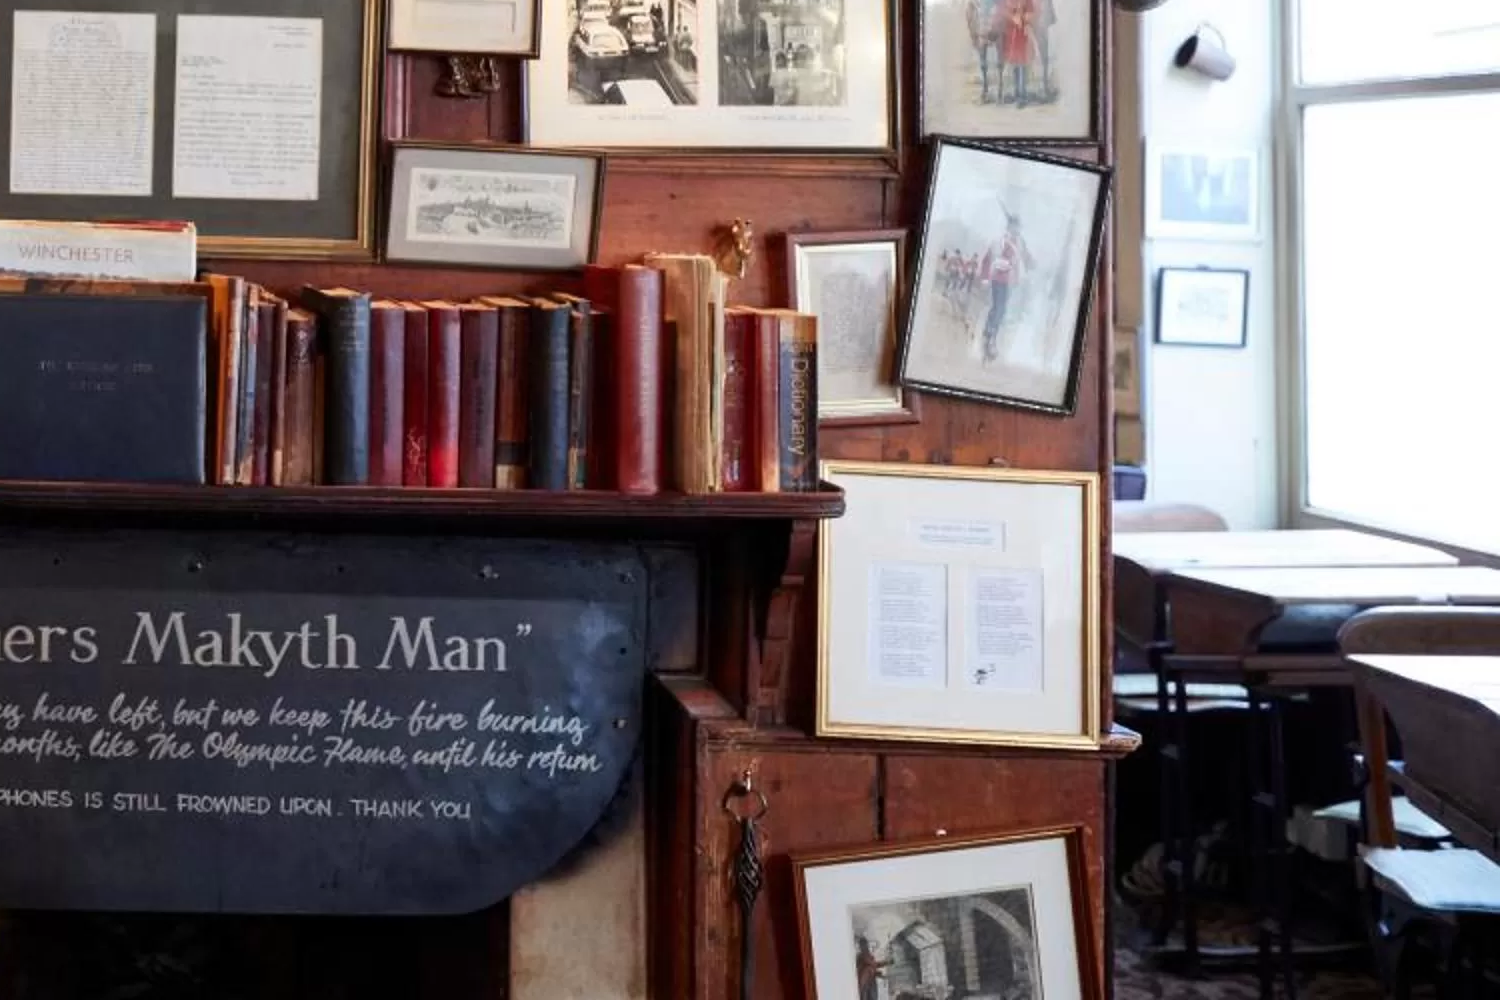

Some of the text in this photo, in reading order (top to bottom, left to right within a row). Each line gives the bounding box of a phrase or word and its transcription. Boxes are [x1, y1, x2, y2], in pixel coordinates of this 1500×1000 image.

[17, 243, 136, 264] WINCHESTER
[787, 358, 809, 455] Dictionary
[121, 611, 360, 678] Makyth
[32, 692, 99, 724] have
[108, 692, 165, 730] left,
[173, 697, 218, 728] but
[221, 704, 261, 728] we
[268, 696, 332, 732] keep
[340, 698, 402, 731] this
[408, 699, 469, 736] fire
[477, 698, 590, 746] burning
[88, 731, 139, 759] like
[147, 733, 196, 761] The
[202, 731, 318, 770] Olympic
[321, 736, 410, 770] Flame,
[411, 738, 478, 773] until
[480, 742, 525, 769] his
[526, 743, 603, 778] return
[84, 791, 104, 811] IS
[112, 792, 168, 813] STILL
[177, 794, 271, 816] FROWNED
[348, 798, 424, 819] THANK
[428, 800, 473, 821] YOU
